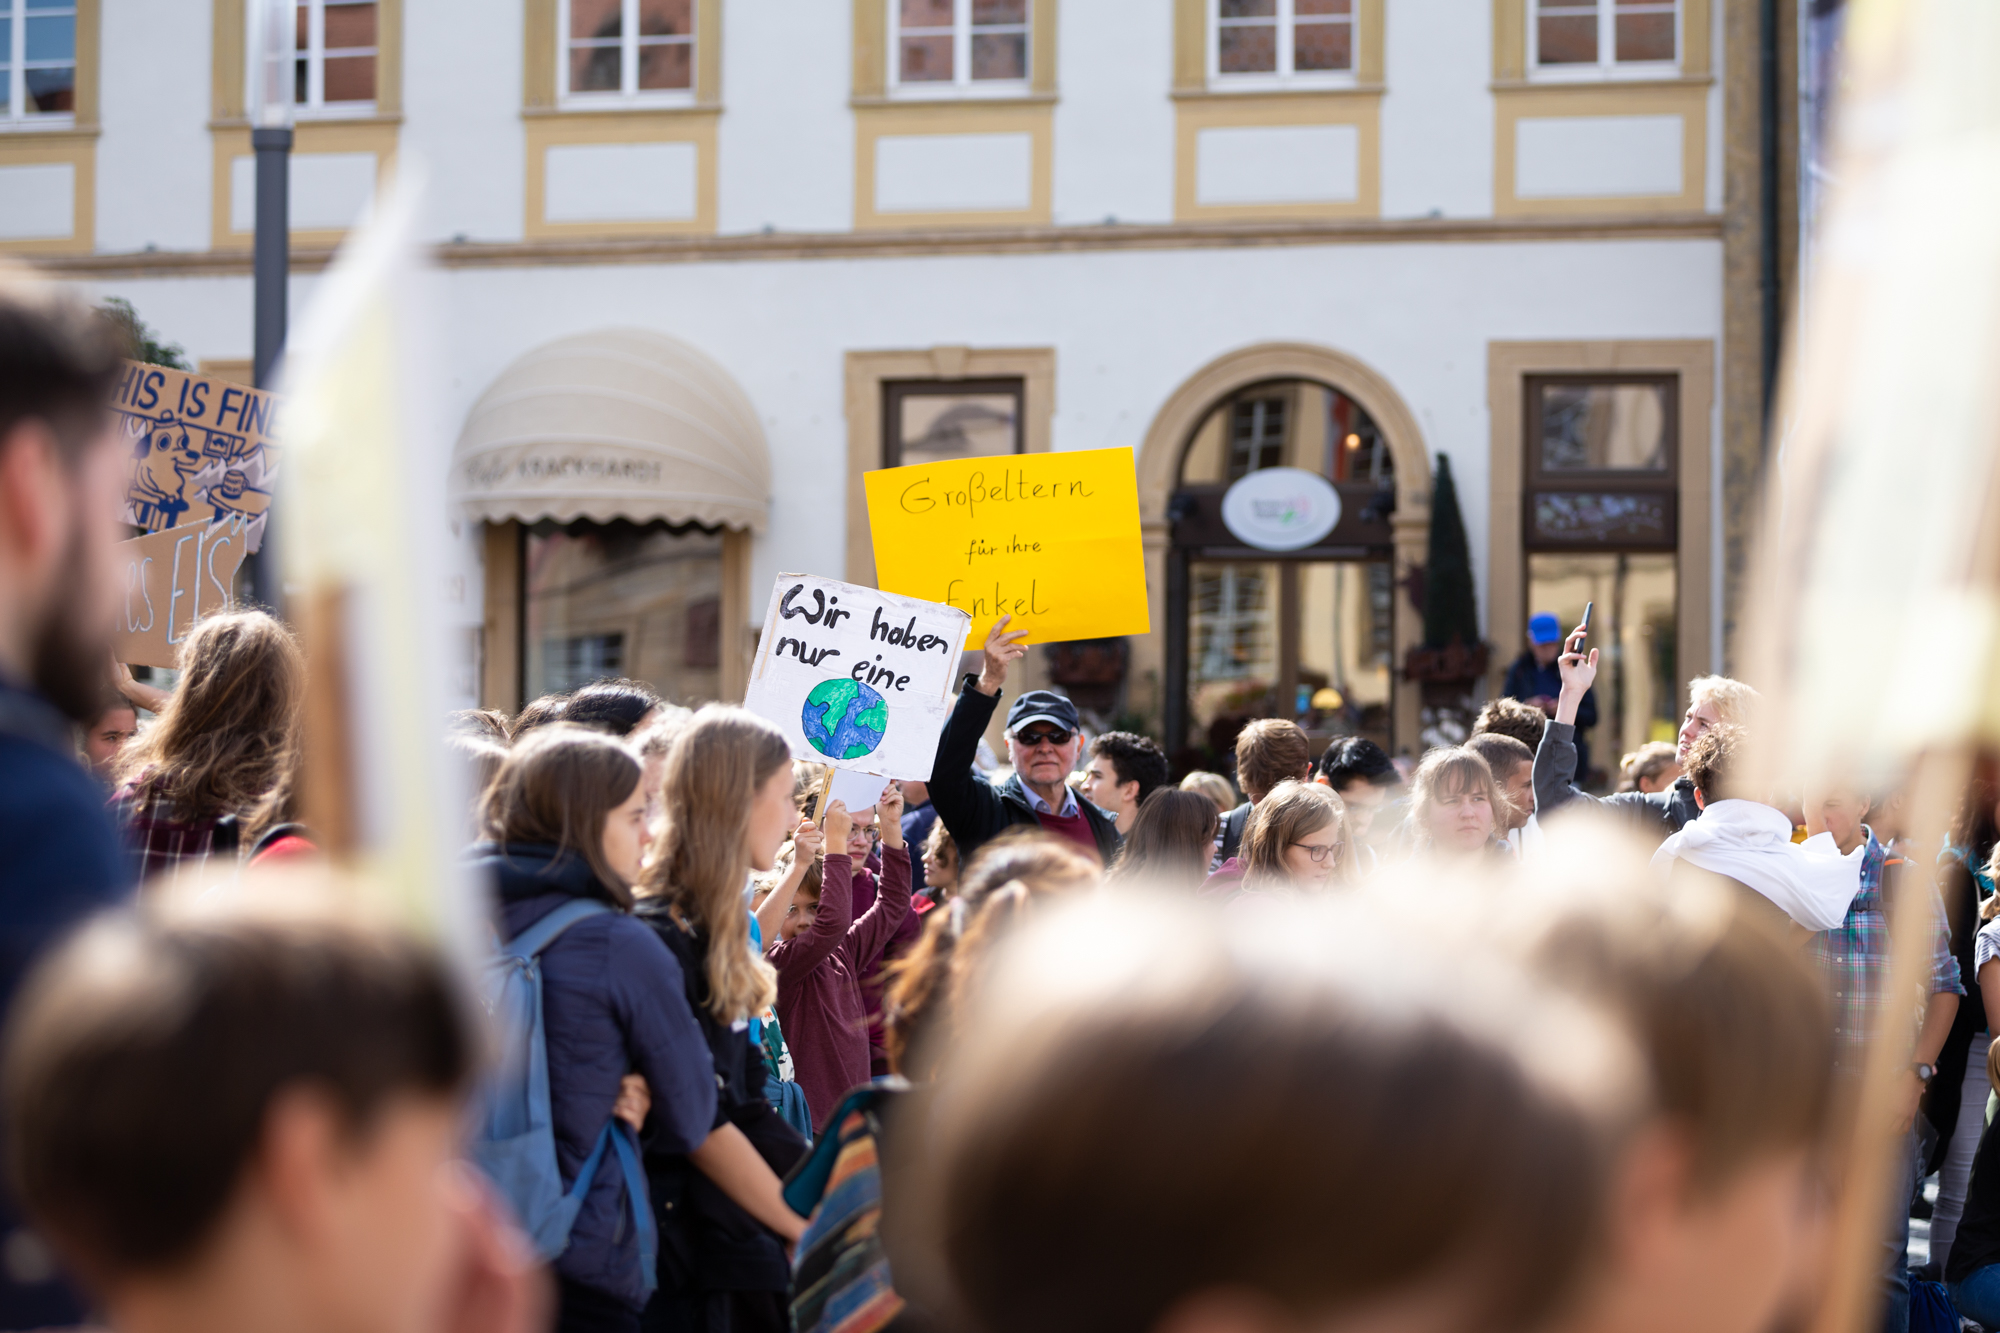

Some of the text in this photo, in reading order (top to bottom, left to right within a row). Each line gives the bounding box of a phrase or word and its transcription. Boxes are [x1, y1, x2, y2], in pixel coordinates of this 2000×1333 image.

[111, 364, 166, 410] HIS
[178, 377, 210, 418] IS
[900, 468, 1095, 518] Großeltern
[964, 533, 1042, 565] für ihre
[779, 583, 949, 654] Wir haben
[775, 636, 911, 691] nur eine
